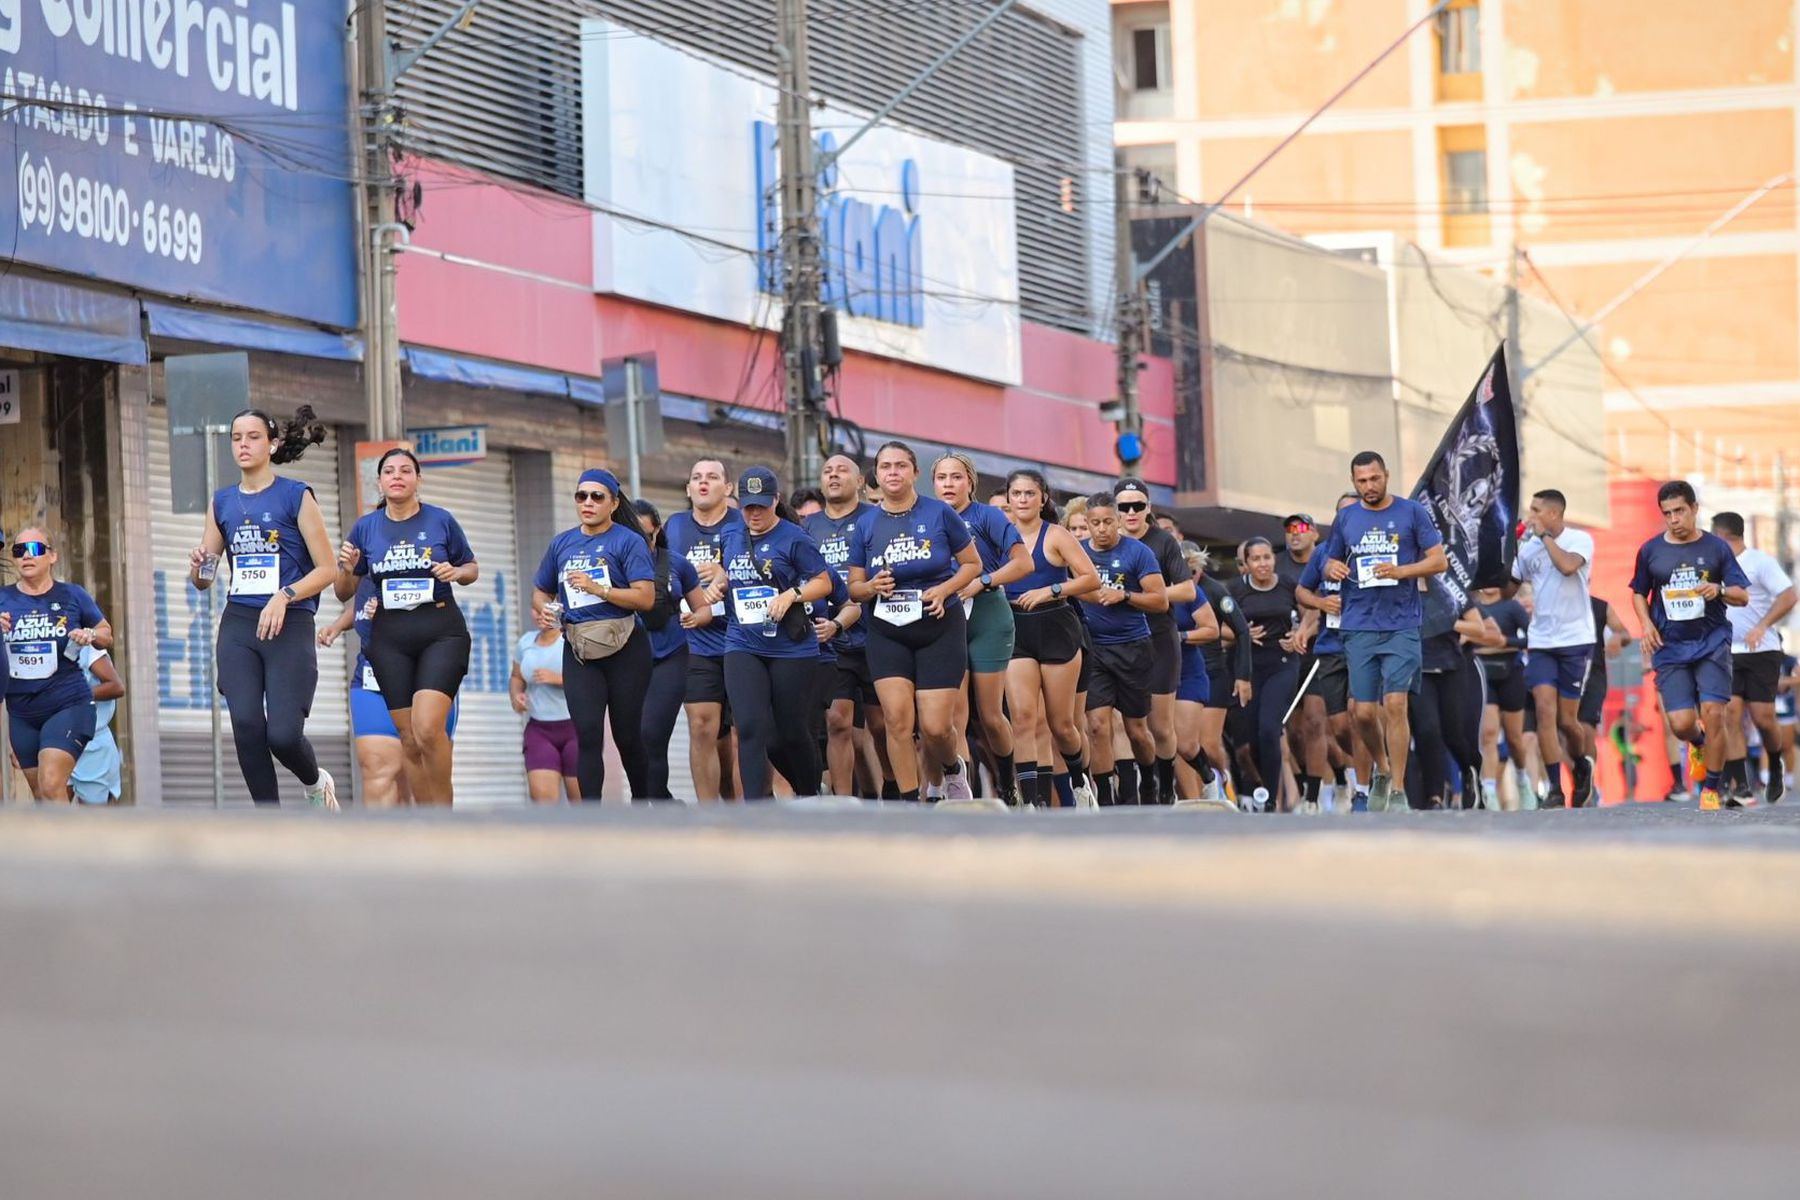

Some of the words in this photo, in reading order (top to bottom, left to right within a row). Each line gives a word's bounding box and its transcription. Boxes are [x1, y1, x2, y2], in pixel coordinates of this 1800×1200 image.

[3, 66, 110, 146] ATACADO
[123, 101, 139, 157] E
[149, 108, 236, 182] VAREJO
[233, 529, 266, 544] AZUL
[1360, 534, 1390, 545] AZUL
[820, 541, 849, 554] AZUL
[884, 541, 919, 555] AZUL
[1351, 543, 1399, 554] MARINHO
[383, 549, 419, 561] AZUL
[686, 549, 714, 560] AZUL
[871, 550, 932, 567] MARINHO
[372, 558, 432, 574] MARINHO
[563, 558, 592, 571] AZUL
[241, 570, 267, 580] 5750
[1670, 571, 1699, 583] AZUL
[393, 592, 421, 602] 5479
[744, 600, 768, 610] 5061
[885, 604, 911, 613] 3006
[1671, 600, 1694, 608] 1160
[14, 617, 53, 630] AZUL
[3, 626, 67, 642] MARINHO
[18, 656, 44, 665] 5691
